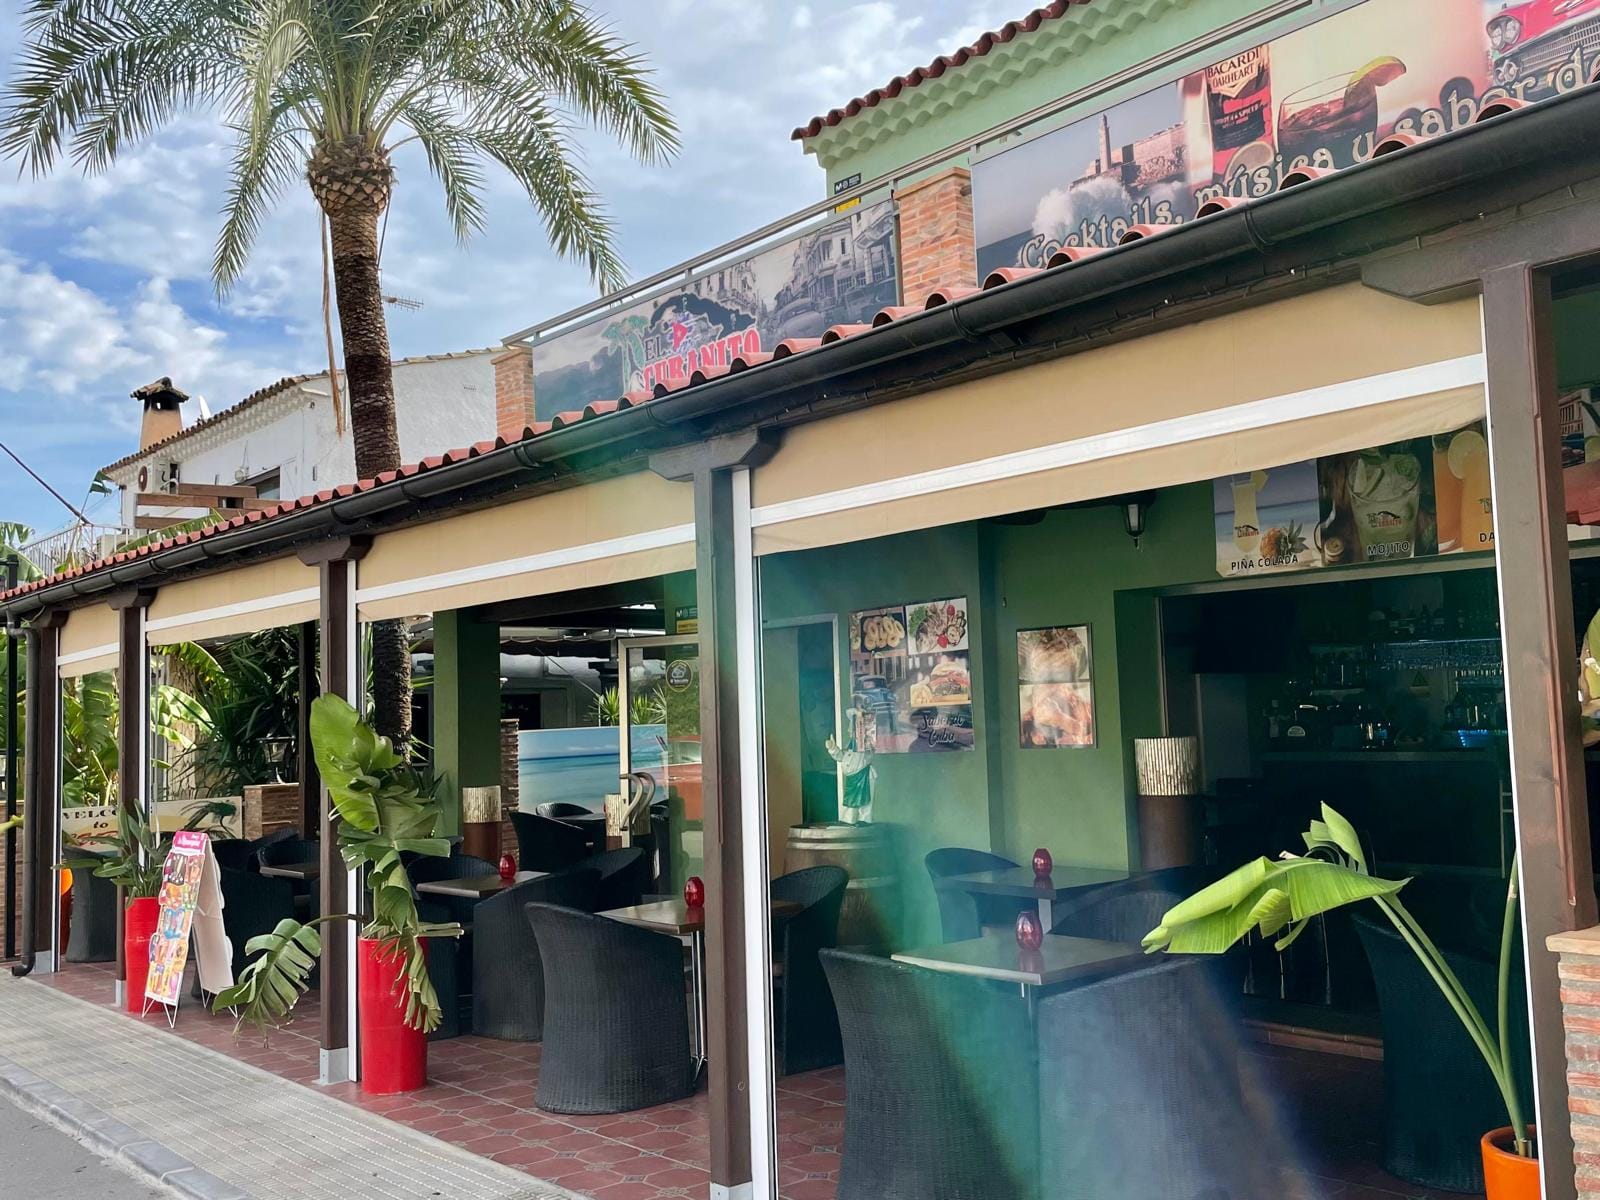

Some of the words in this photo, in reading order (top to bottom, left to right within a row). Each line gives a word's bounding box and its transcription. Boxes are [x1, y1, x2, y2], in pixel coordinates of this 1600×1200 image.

[1208, 48, 1259, 78] BACARDI
[1212, 63, 1255, 88] OAKHEART
[643, 328, 760, 392] CUBANITO
[645, 336, 663, 361] EL
[1367, 541, 1409, 556] MOJITO
[1231, 558, 1255, 570] PIÑA
[1257, 555, 1299, 568] COLADA
[93, 820, 109, 829] to
